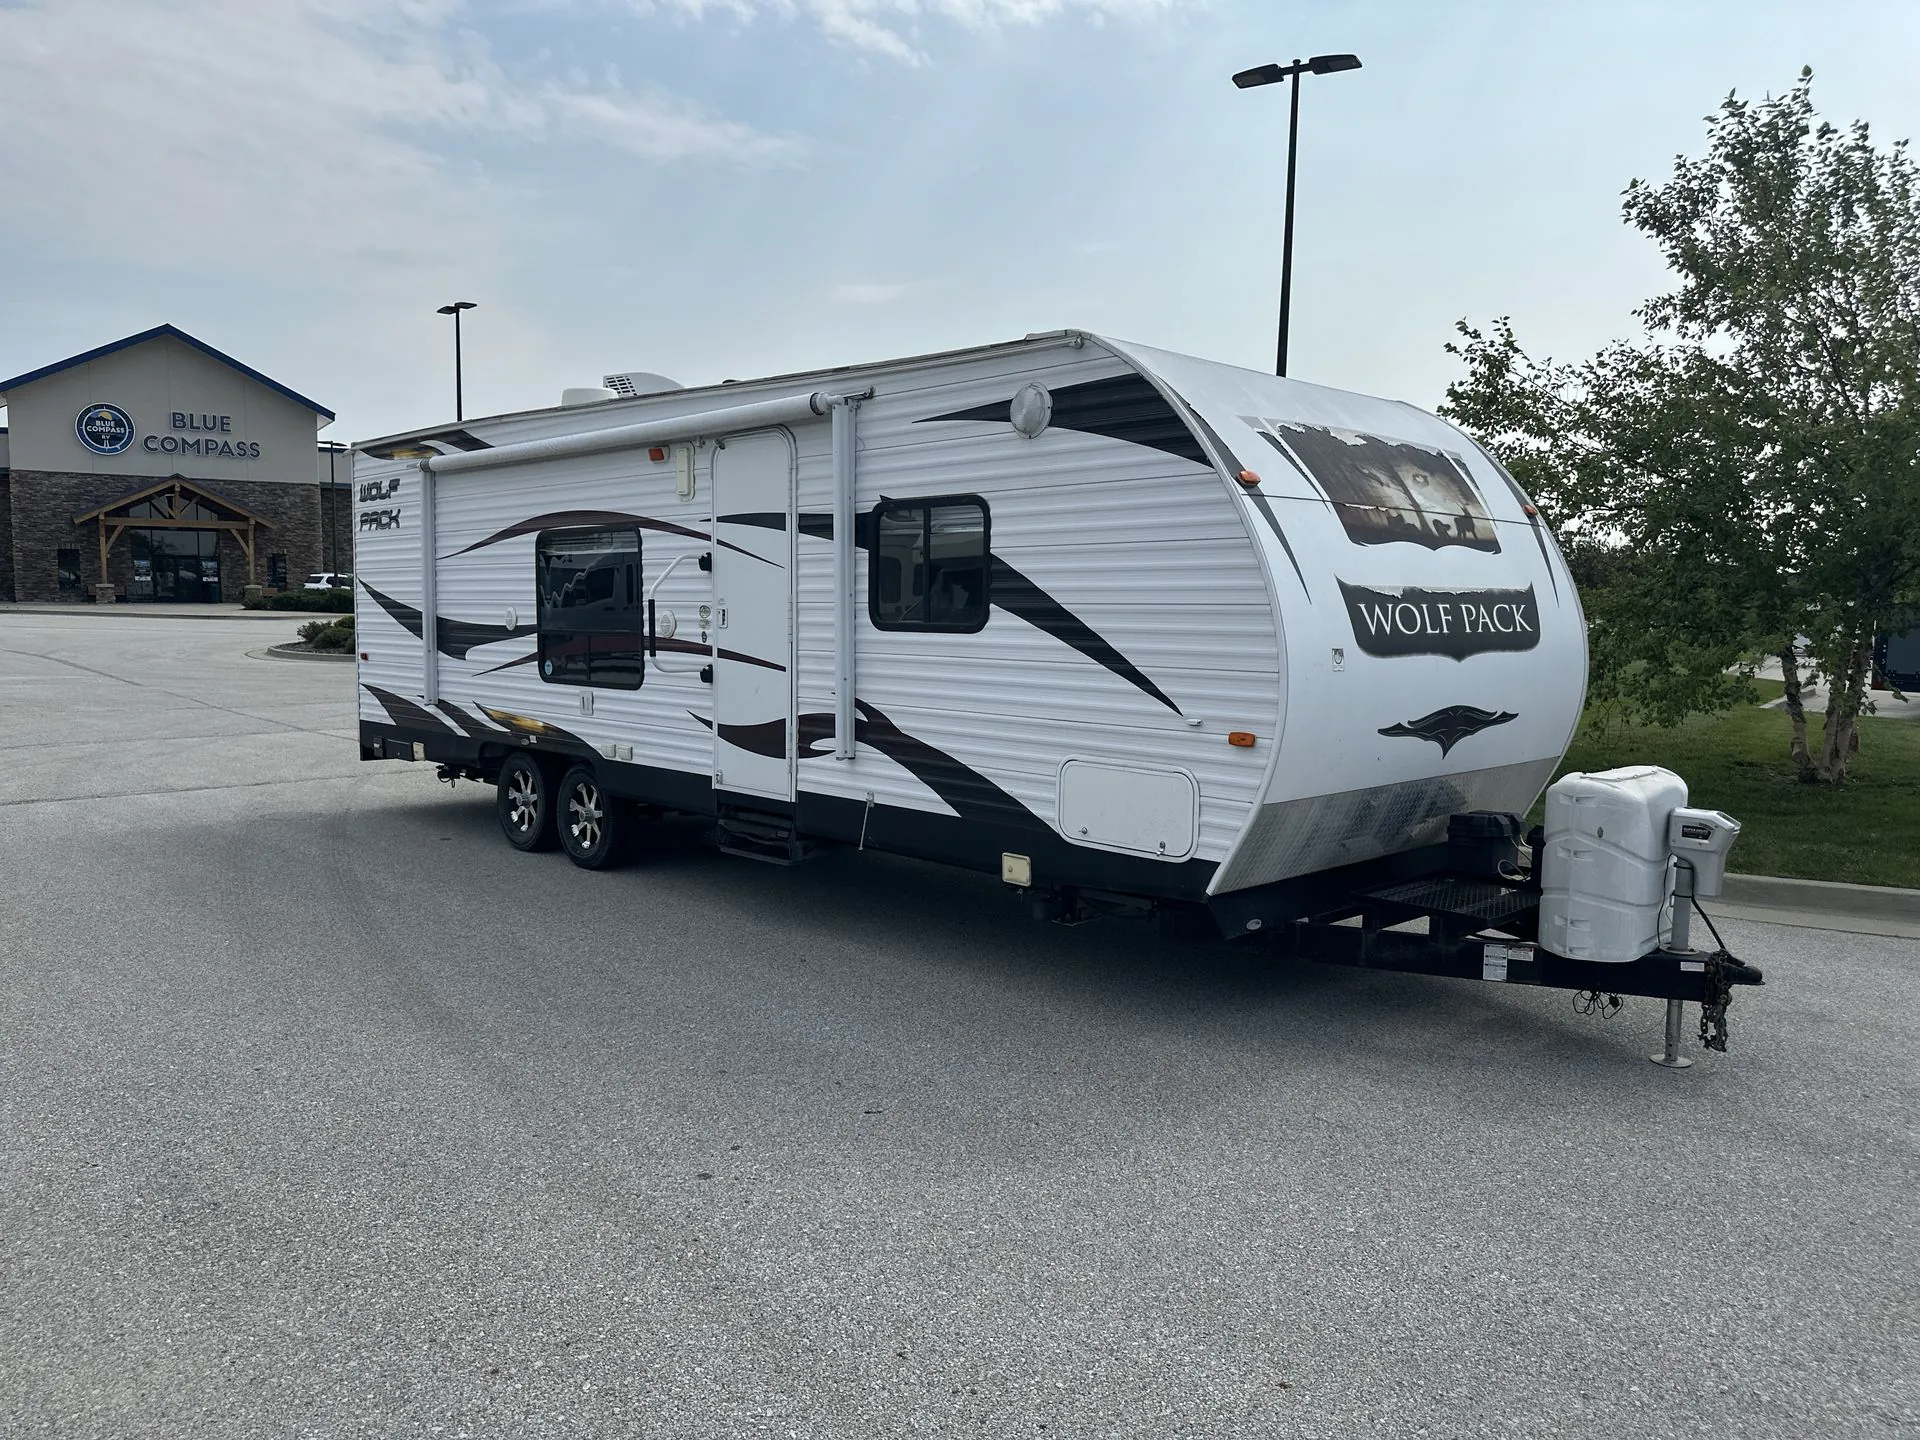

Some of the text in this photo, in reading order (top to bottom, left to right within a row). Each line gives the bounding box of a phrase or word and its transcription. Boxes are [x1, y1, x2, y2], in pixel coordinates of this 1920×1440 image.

[86, 425, 125, 434] COMPASS
[171, 411, 232, 433] BLUE
[142, 435, 261, 458] COMPASS
[359, 478, 401, 502] WOLF
[359, 508, 401, 532] PACK
[1356, 603, 1534, 636] WOLF PACK
